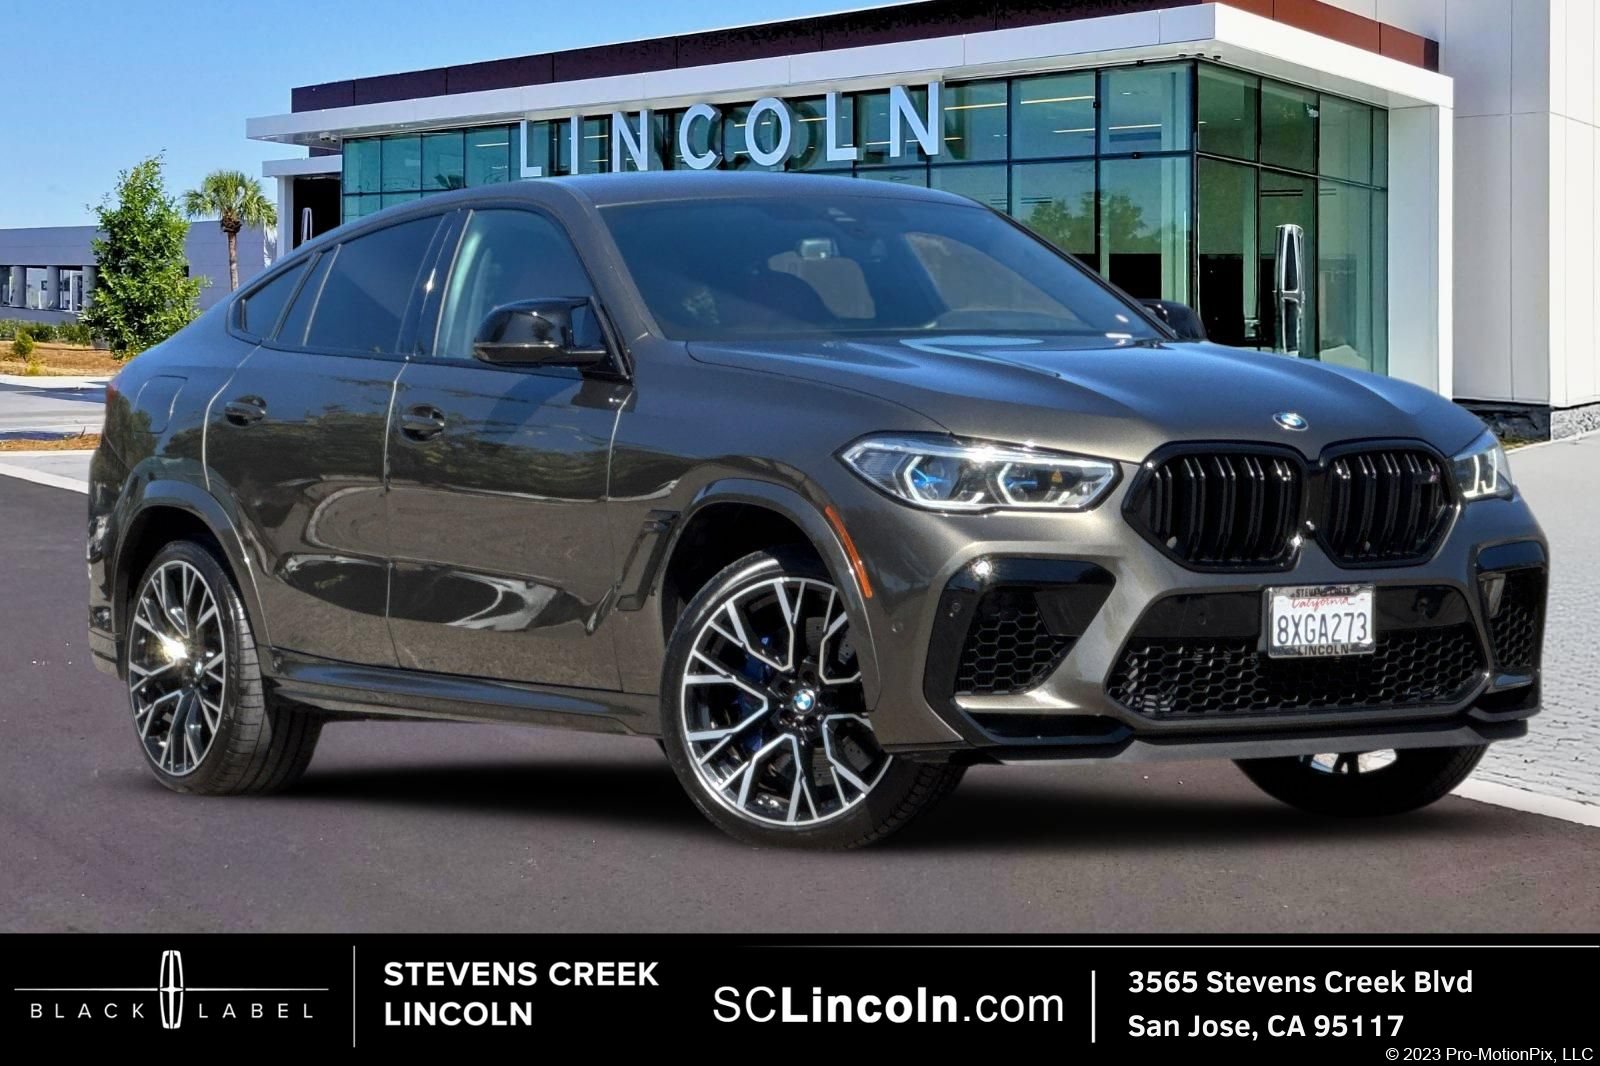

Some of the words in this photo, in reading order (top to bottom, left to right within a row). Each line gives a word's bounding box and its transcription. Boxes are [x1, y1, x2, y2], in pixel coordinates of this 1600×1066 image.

[519, 81, 943, 178] LINCOLN
[1277, 612, 1367, 644] 8XGA273
[1296, 644, 1349, 656] LINCOLN
